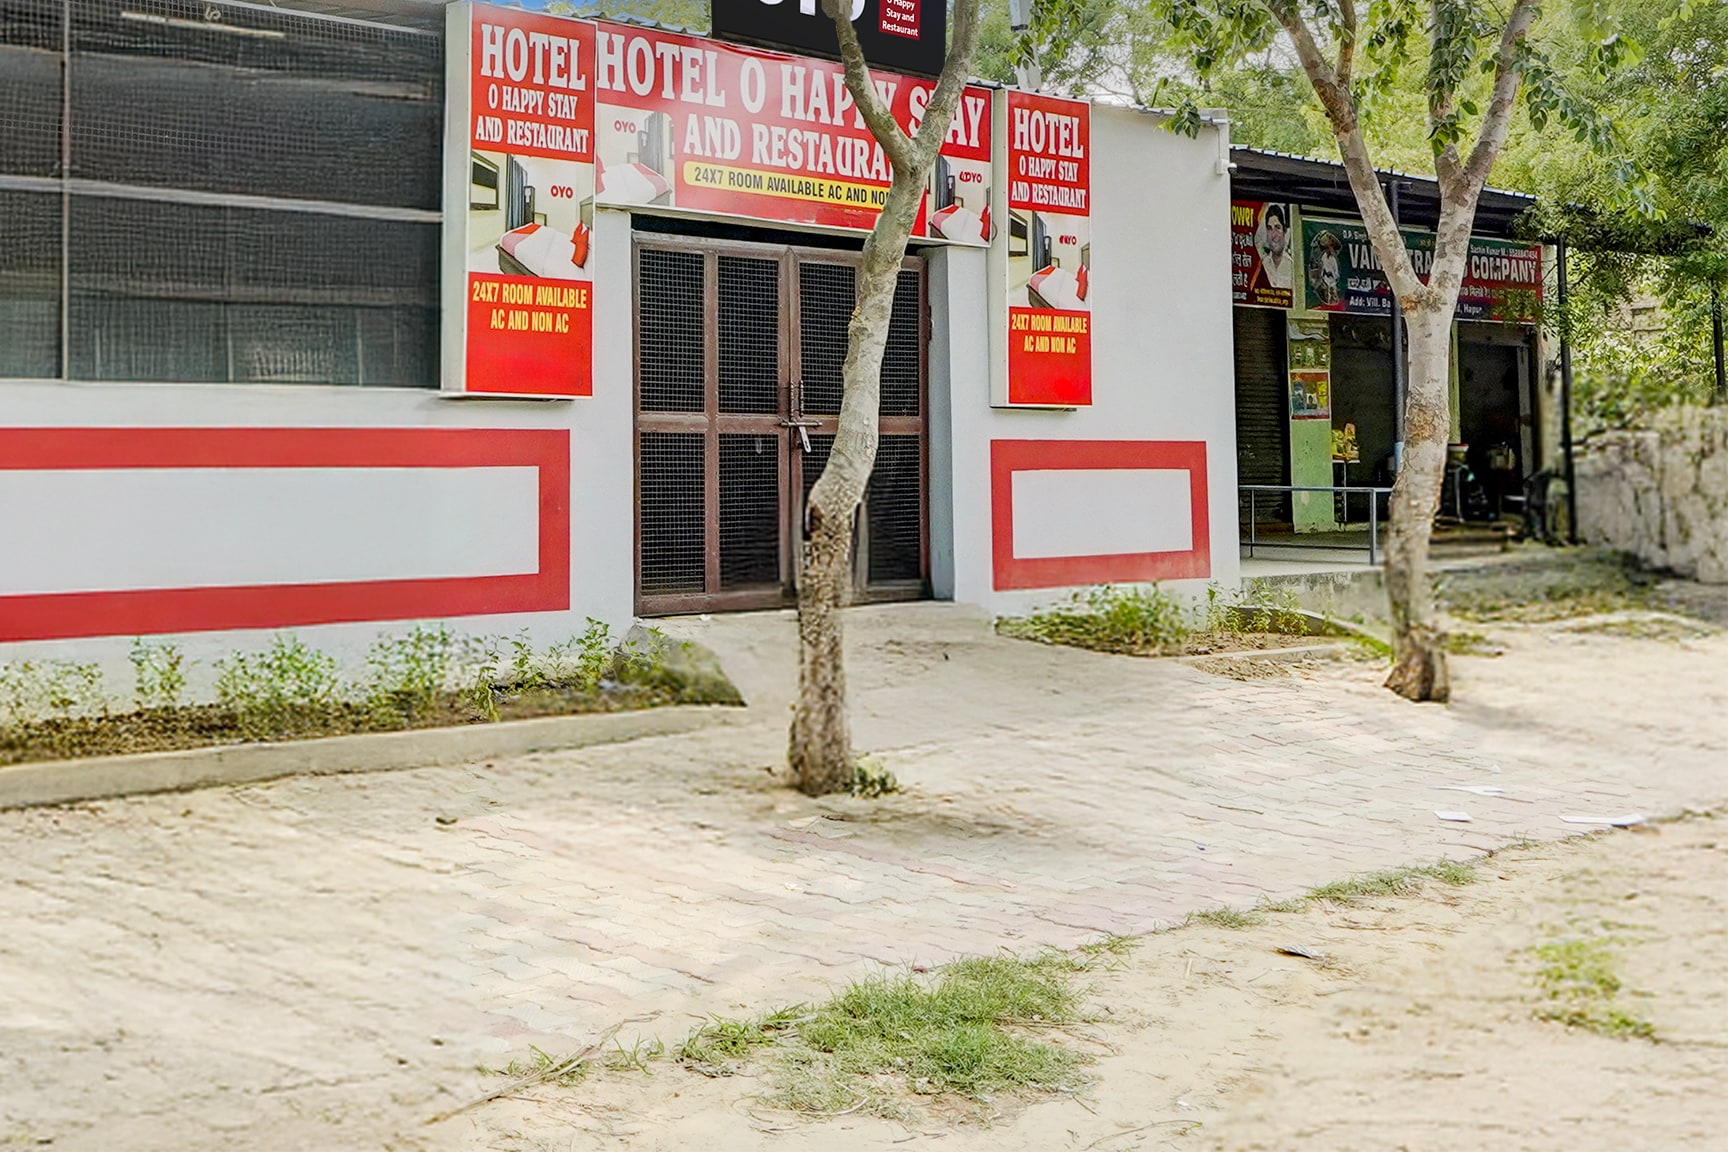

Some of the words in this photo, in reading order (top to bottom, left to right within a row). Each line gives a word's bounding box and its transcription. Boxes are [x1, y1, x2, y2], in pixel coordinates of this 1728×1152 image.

[882, 20, 918, 37] Restaurant
[886, 7, 901, 21] Stay
[901, 13, 915, 23] and
[480, 24, 585, 91] HOTEL
[488, 83, 499, 109] O
[502, 86, 544, 115] HAPPY
[548, 92, 577, 120] STAY
[597, 31, 725, 107] HOTEL
[740, 57, 766, 113] O
[909, 86, 985, 148] SAY
[475, 115, 503, 143] AND
[507, 119, 589, 153] RESTAURANT
[614, 119, 636, 134] OYO
[1013, 107, 1084, 158] HOTEL
[683, 113, 741, 160] AND
[752, 123, 894, 182] RESTAURA
[1019, 155, 1026, 176] O
[1028, 156, 1056, 179] HAPPY
[1058, 160, 1078, 182] STAY
[551, 185, 573, 198] OYO
[694, 167, 724, 184] 24X7
[728, 171, 763, 189] ROOM
[767, 176, 824, 197] AVAILABLE
[828, 185, 842, 199] AC
[846, 187, 867, 203] AND
[871, 190, 889, 205] NO
[1011, 181, 1030, 202] AND
[1032, 183, 1086, 209] RESTAURANT
[1472, 255, 1537, 284] COMPANY
[472, 281, 499, 302] 24X7
[502, 283, 533, 305] ROOM
[536, 286, 587, 309] AVAILABLE
[490, 309, 505, 329] AC
[508, 310, 529, 330] AND
[532, 311, 553, 332] NON
[555, 313, 569, 333] AC
[1012, 314, 1029, 330] 24X7
[1032, 315, 1052, 332] ROOM
[1053, 316, 1087, 333] AVAILABLE
[1024, 335, 1034, 352] AC
[1035, 336, 1050, 353] AND
[1051, 337, 1065, 353] NON
[1066, 337, 1076, 354] AC
